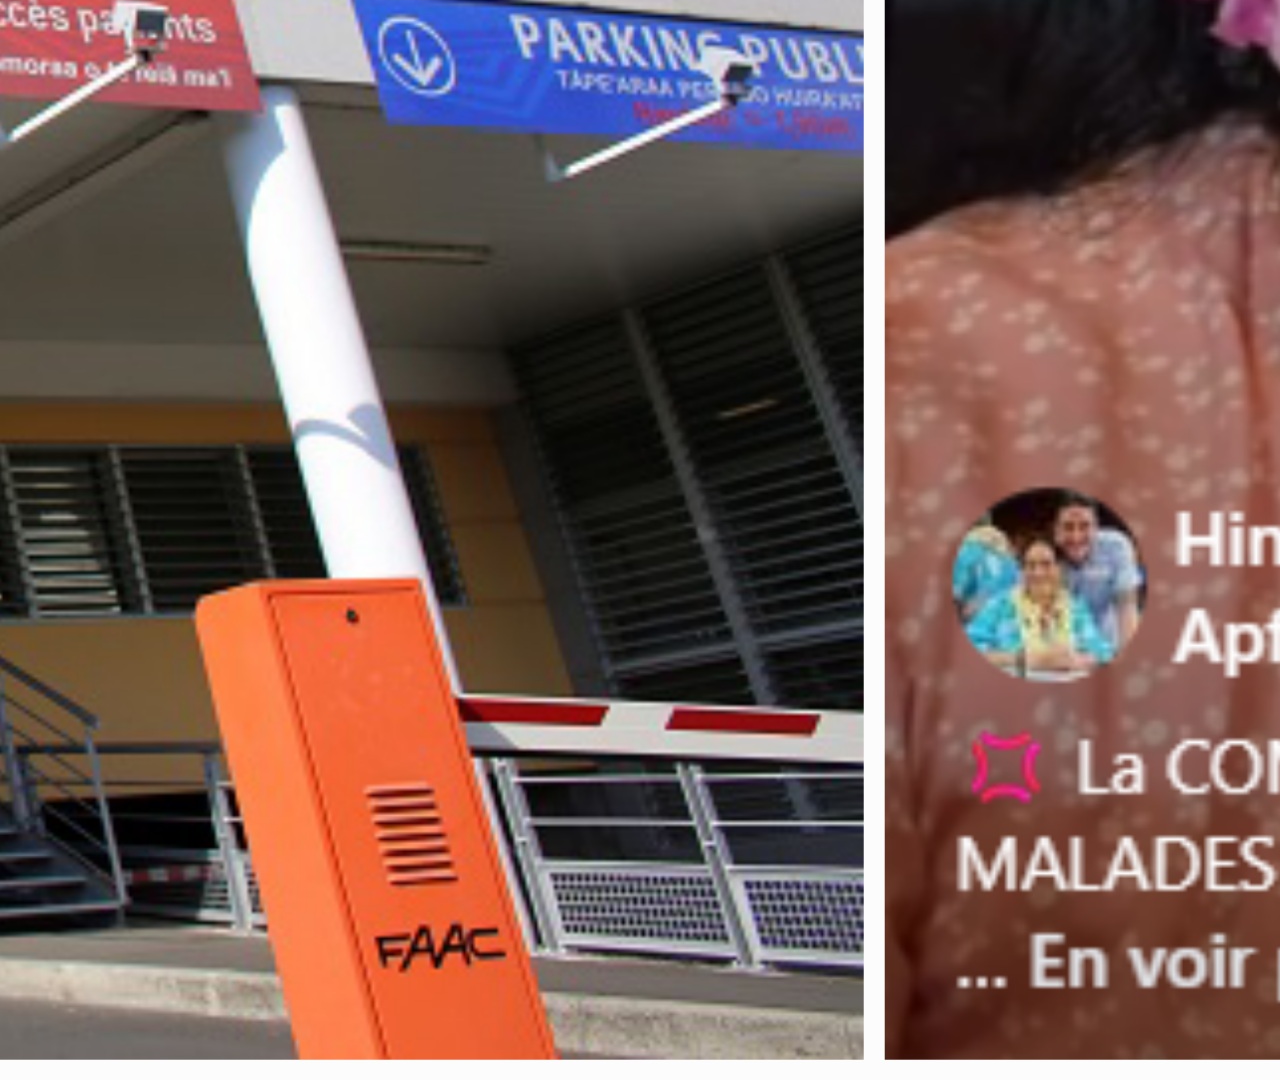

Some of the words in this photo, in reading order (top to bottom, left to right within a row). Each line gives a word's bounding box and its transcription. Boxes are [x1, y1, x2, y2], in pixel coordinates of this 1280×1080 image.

[77, 5, 217, 44] pants
[737, 33, 864, 85] PUBL
[375, 924, 506, 972] FAAC
